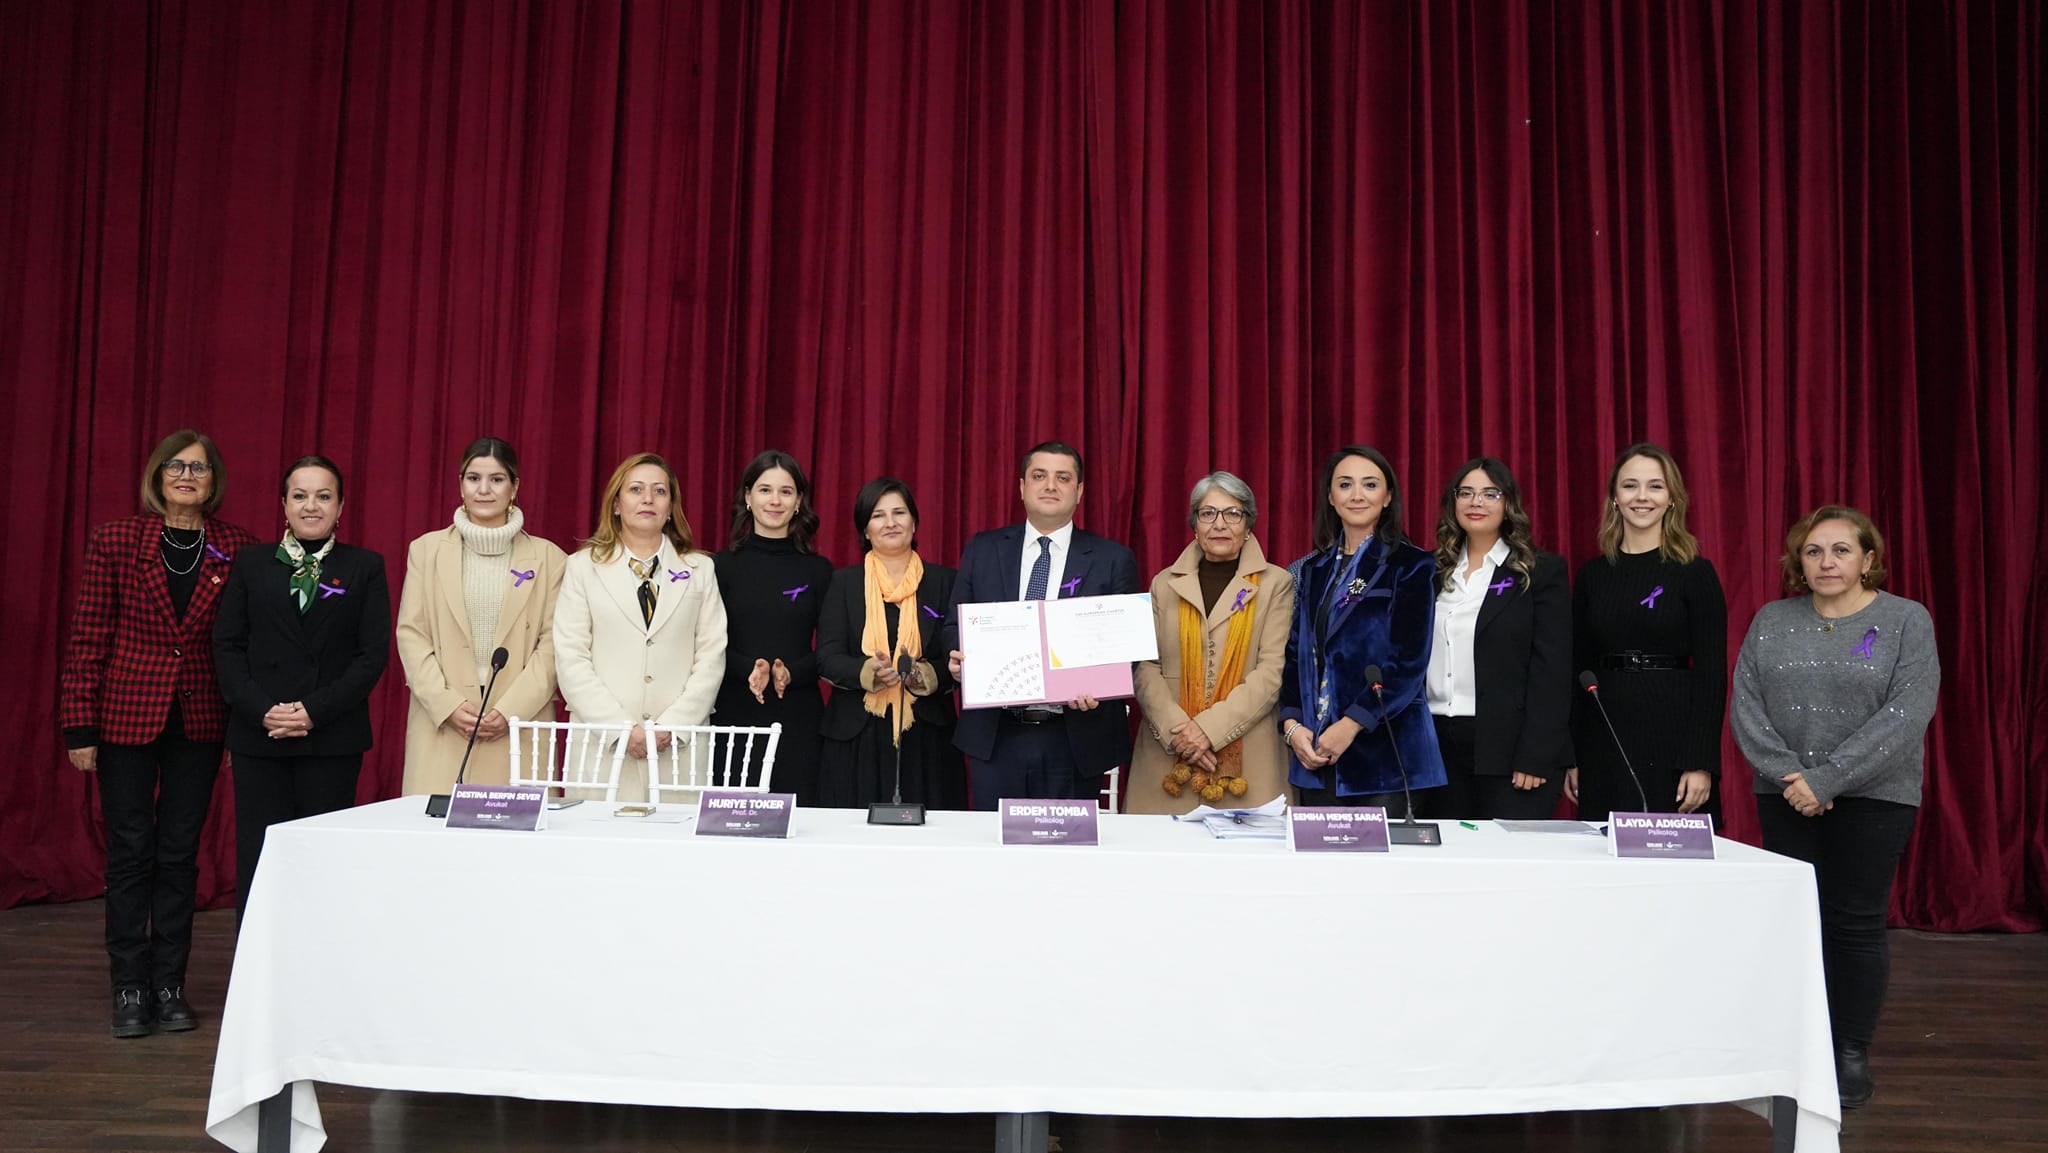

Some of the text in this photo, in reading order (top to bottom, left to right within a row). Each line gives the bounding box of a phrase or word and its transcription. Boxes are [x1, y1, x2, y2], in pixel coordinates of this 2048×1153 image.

[516, 793, 541, 801] SEVER
[749, 799, 784, 809] TOKER
[1009, 806, 1089, 816] ERDEM TOMBA
[1034, 817, 1065, 825] Psikolog
[1655, 818, 1708, 829] ADIGÜZEL
[1647, 829, 1679, 837] Psikolog
